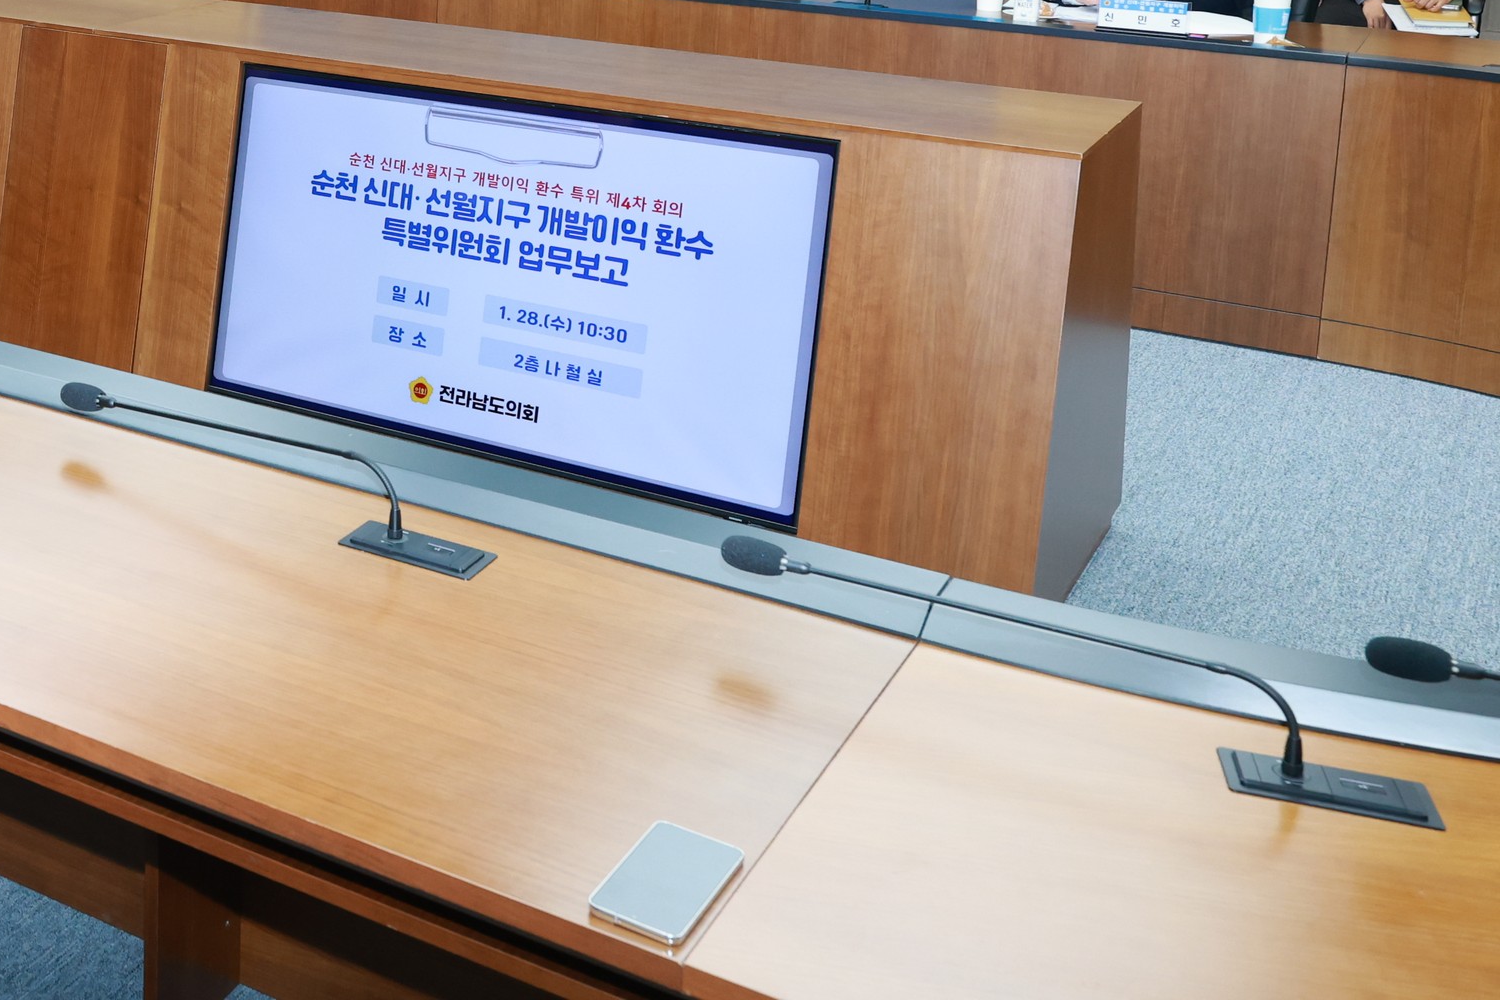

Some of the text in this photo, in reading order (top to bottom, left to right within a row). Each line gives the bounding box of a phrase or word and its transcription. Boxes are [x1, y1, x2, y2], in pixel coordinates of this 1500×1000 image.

[349, 152, 684, 218] 순천 신대·선월지구 개발이익 환수 특위 제4차 회의
[311, 169, 359, 202] 순천
[537, 205, 649, 251] 개발이익
[654, 223, 714, 261] 환수
[381, 217, 629, 288] 특별위원회 업무보고
[577, 320, 629, 344] 10:30
[513, 353, 540, 374] 2층
[439, 384, 540, 423] 전라남도의회
